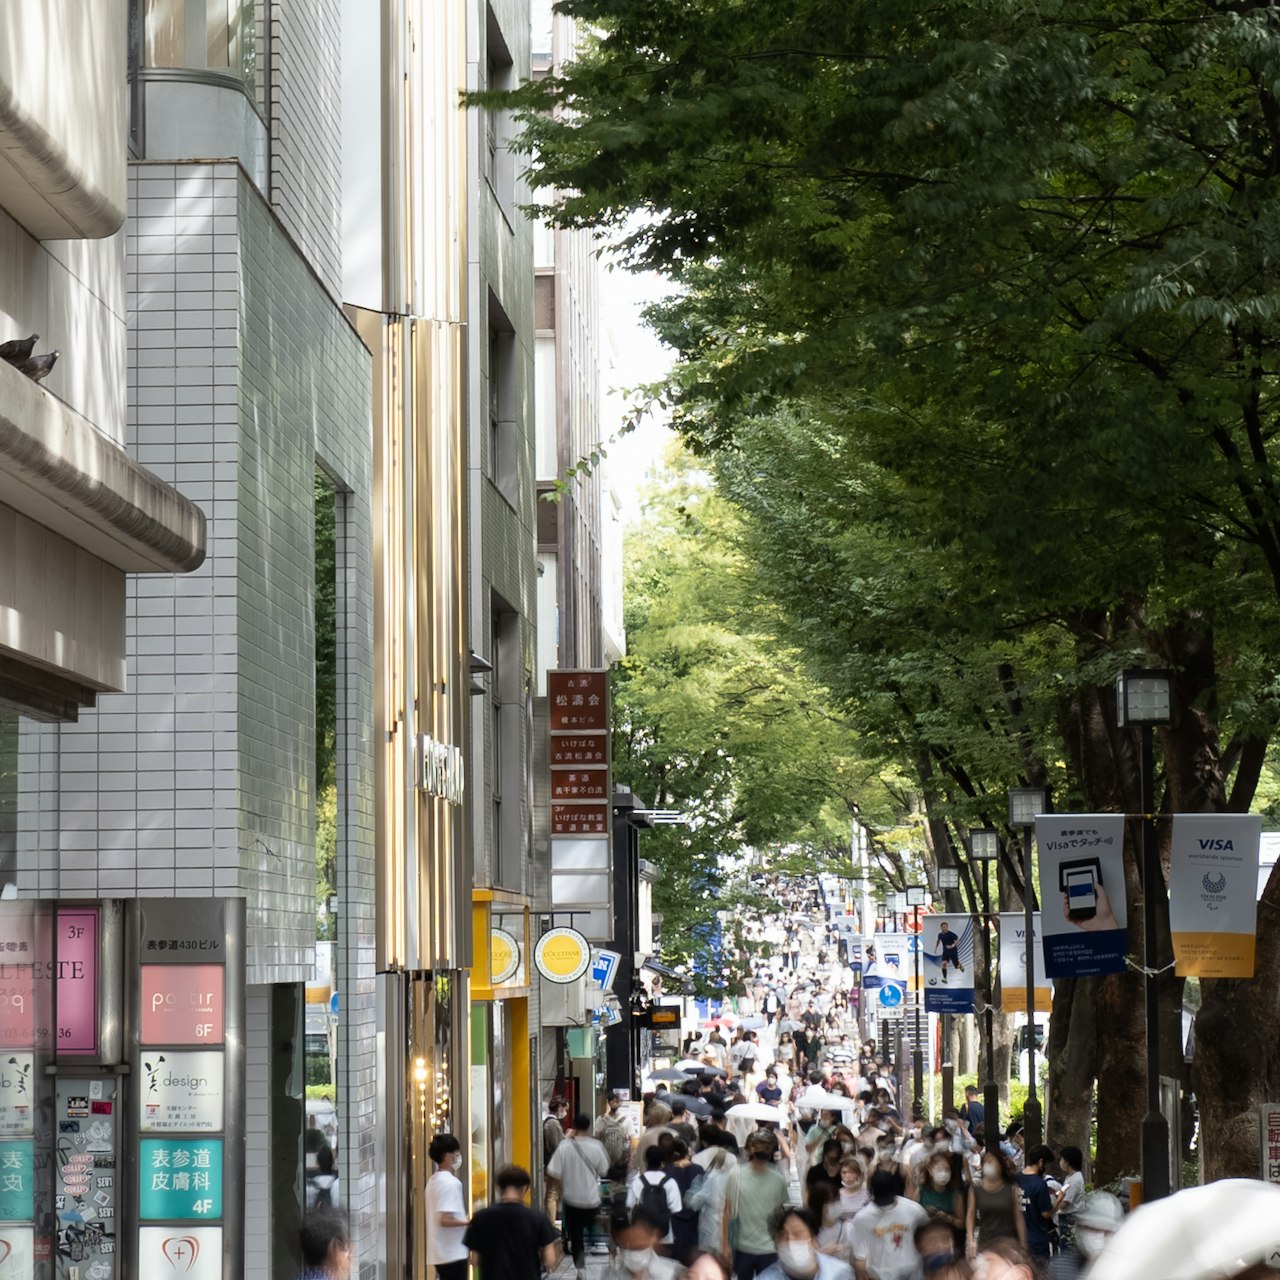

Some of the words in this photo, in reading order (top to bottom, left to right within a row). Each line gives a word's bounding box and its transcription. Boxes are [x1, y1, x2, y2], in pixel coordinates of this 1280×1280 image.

[1197, 839, 1234, 851] VISA
[67, 926, 85, 938] 3F
[147, 940, 219, 950] 表参道430ビル
[195, 1023, 213, 1037] 6F
[152, 1148, 211, 1168] 表参道
[152, 1171, 211, 1191] 皮膚科
[192, 1199, 213, 1213] 4F
